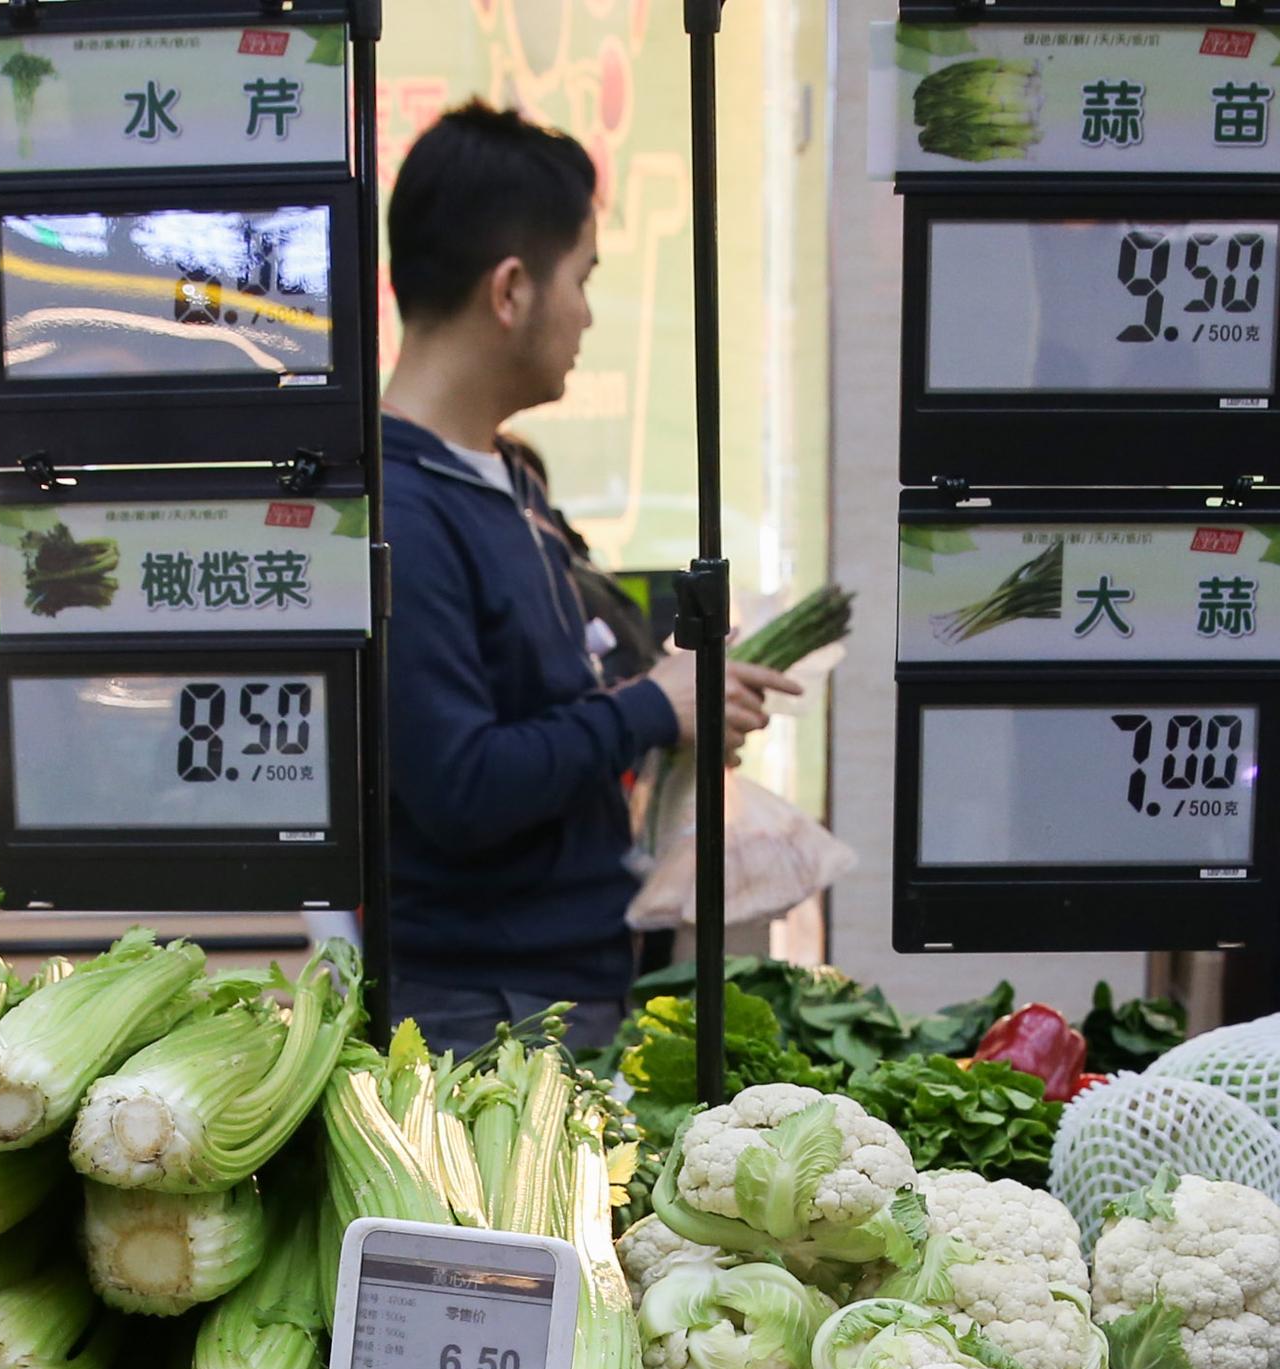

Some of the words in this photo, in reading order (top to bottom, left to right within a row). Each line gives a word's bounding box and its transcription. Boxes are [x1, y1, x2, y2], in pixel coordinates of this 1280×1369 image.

[123, 77, 300, 139] 水芹
[1081, 79, 1271, 144] 蒜苗
[1115, 231, 1266, 343] 9.50
[1191, 323, 1261, 343] /500克
[140, 549, 310, 607] 橄榄菜
[1073, 574, 1255, 634] 大蒜
[176, 682, 313, 783] 8.50
[251, 764, 315, 783] /500克
[1110, 713, 1243, 818] 7.00
[1172, 799, 1240, 818] /500克
